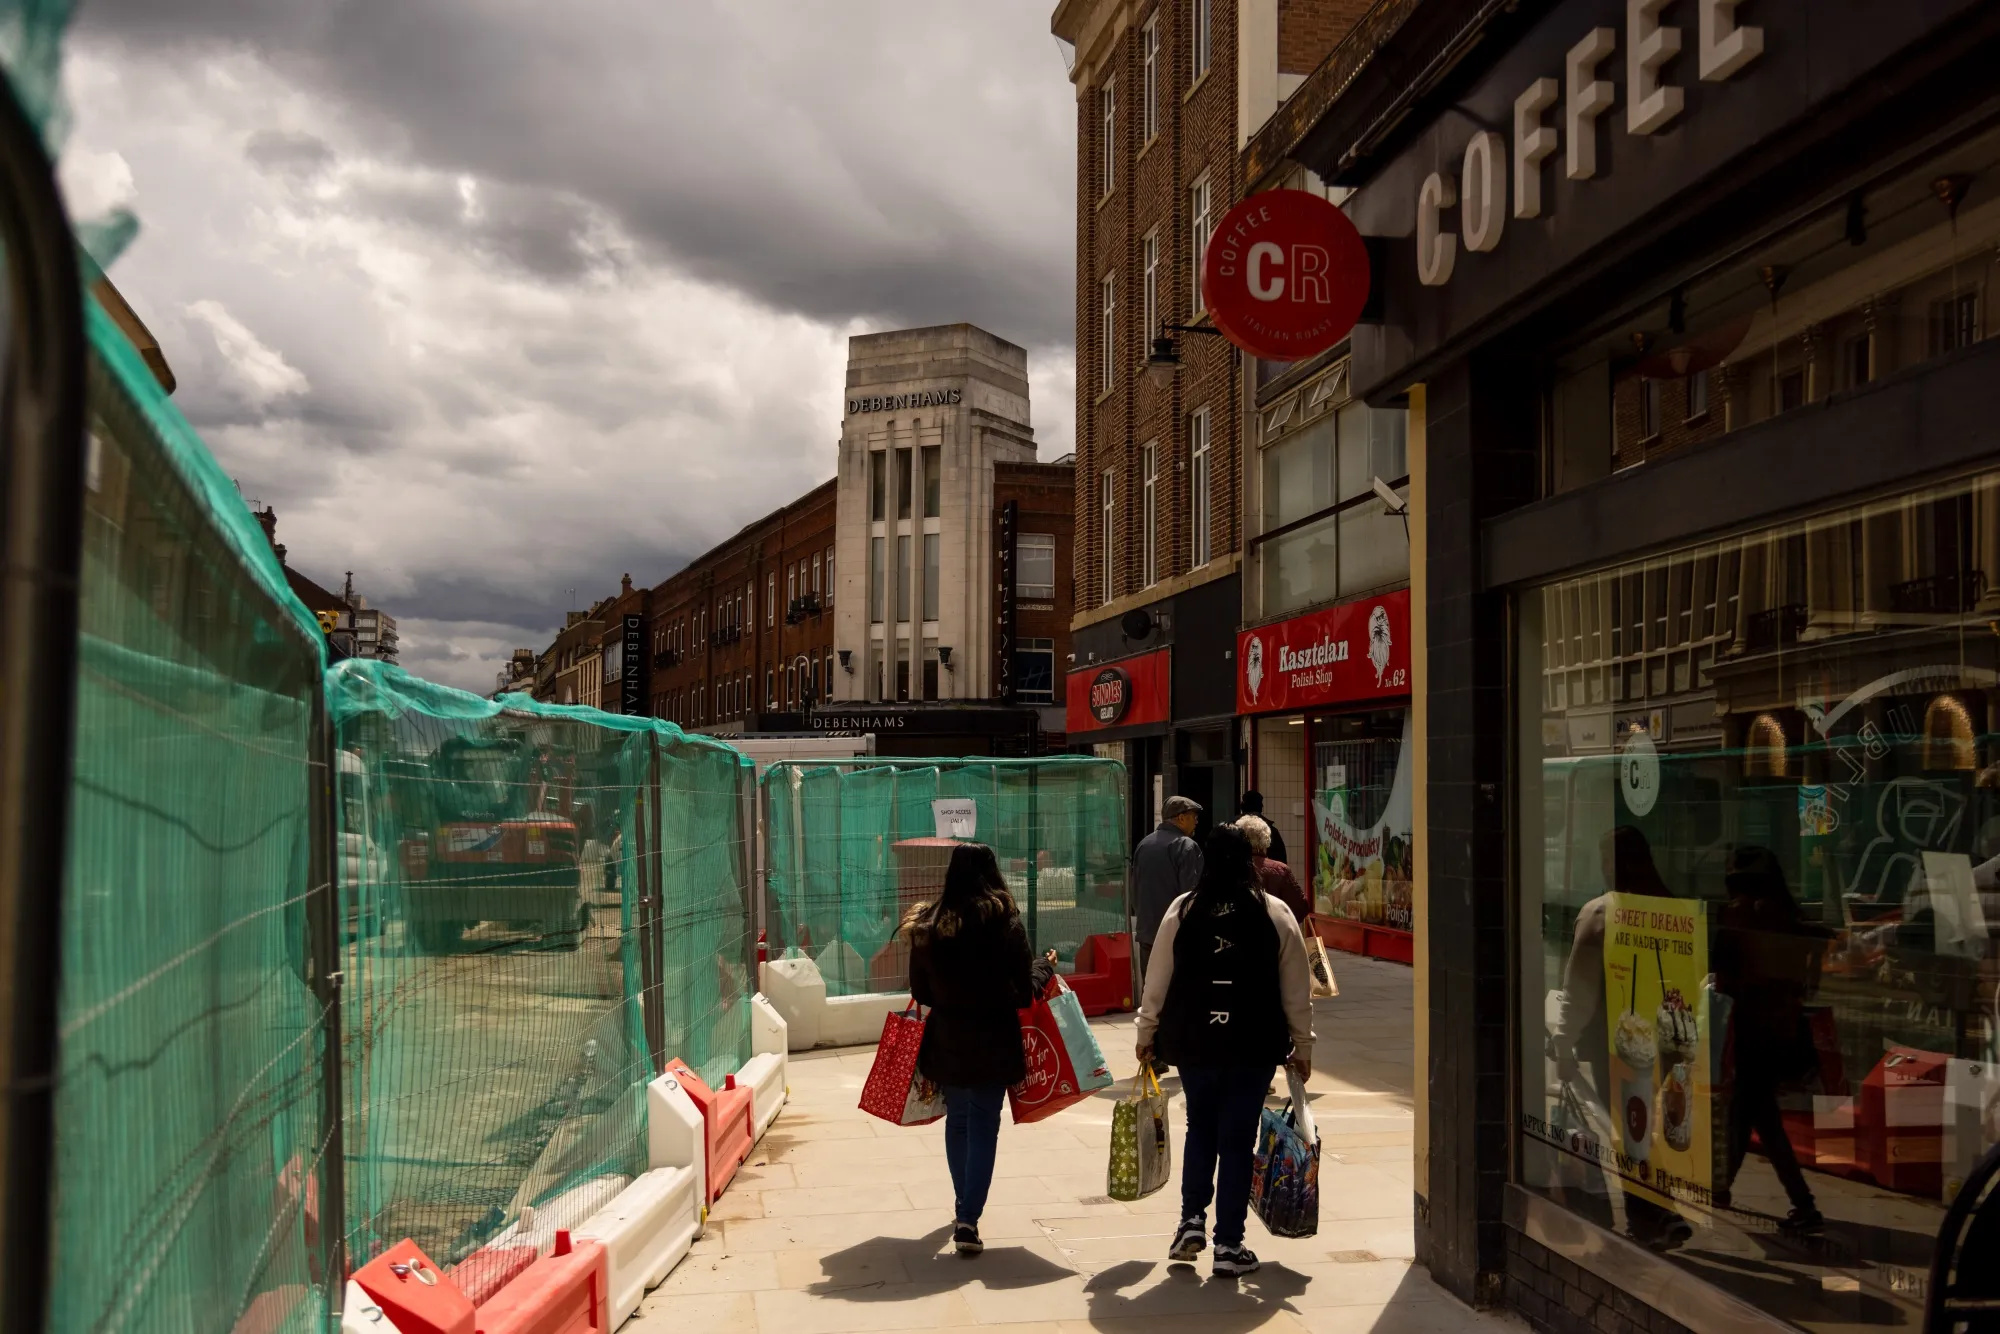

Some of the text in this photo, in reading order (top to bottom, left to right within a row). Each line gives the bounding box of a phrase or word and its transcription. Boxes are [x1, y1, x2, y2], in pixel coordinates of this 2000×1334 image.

[1219, 205, 1272, 276] COFFEE
[1246, 241, 1331, 304] CR
[1243, 314, 1332, 342] ITALIAN ROAST
[848, 388, 962, 414] DEBENHAMS
[1001, 508, 1010, 698] DEBENHAMS
[625, 617, 640, 716] DEBENHA
[1278, 636, 1349, 673] Kasztelan
[1291, 669, 1333, 689] Polish Shop
[1393, 668, 1406, 687] 62
[813, 716, 905, 729] DEBENHAMS
[1324, 816, 1381, 857] Polskie produkty
[1386, 903, 1409, 924] Polish
[1614, 908, 1694, 934] SWEET DREAMS
[1614, 932, 1694, 956] ARE MADE OF THIS
[1021, 1032, 1038, 1053] nly
[1037, 1047, 1050, 1066] for
[1583, 1141, 1633, 1173] AMERICANO
[1685, 1180, 1711, 1206] WHIT
